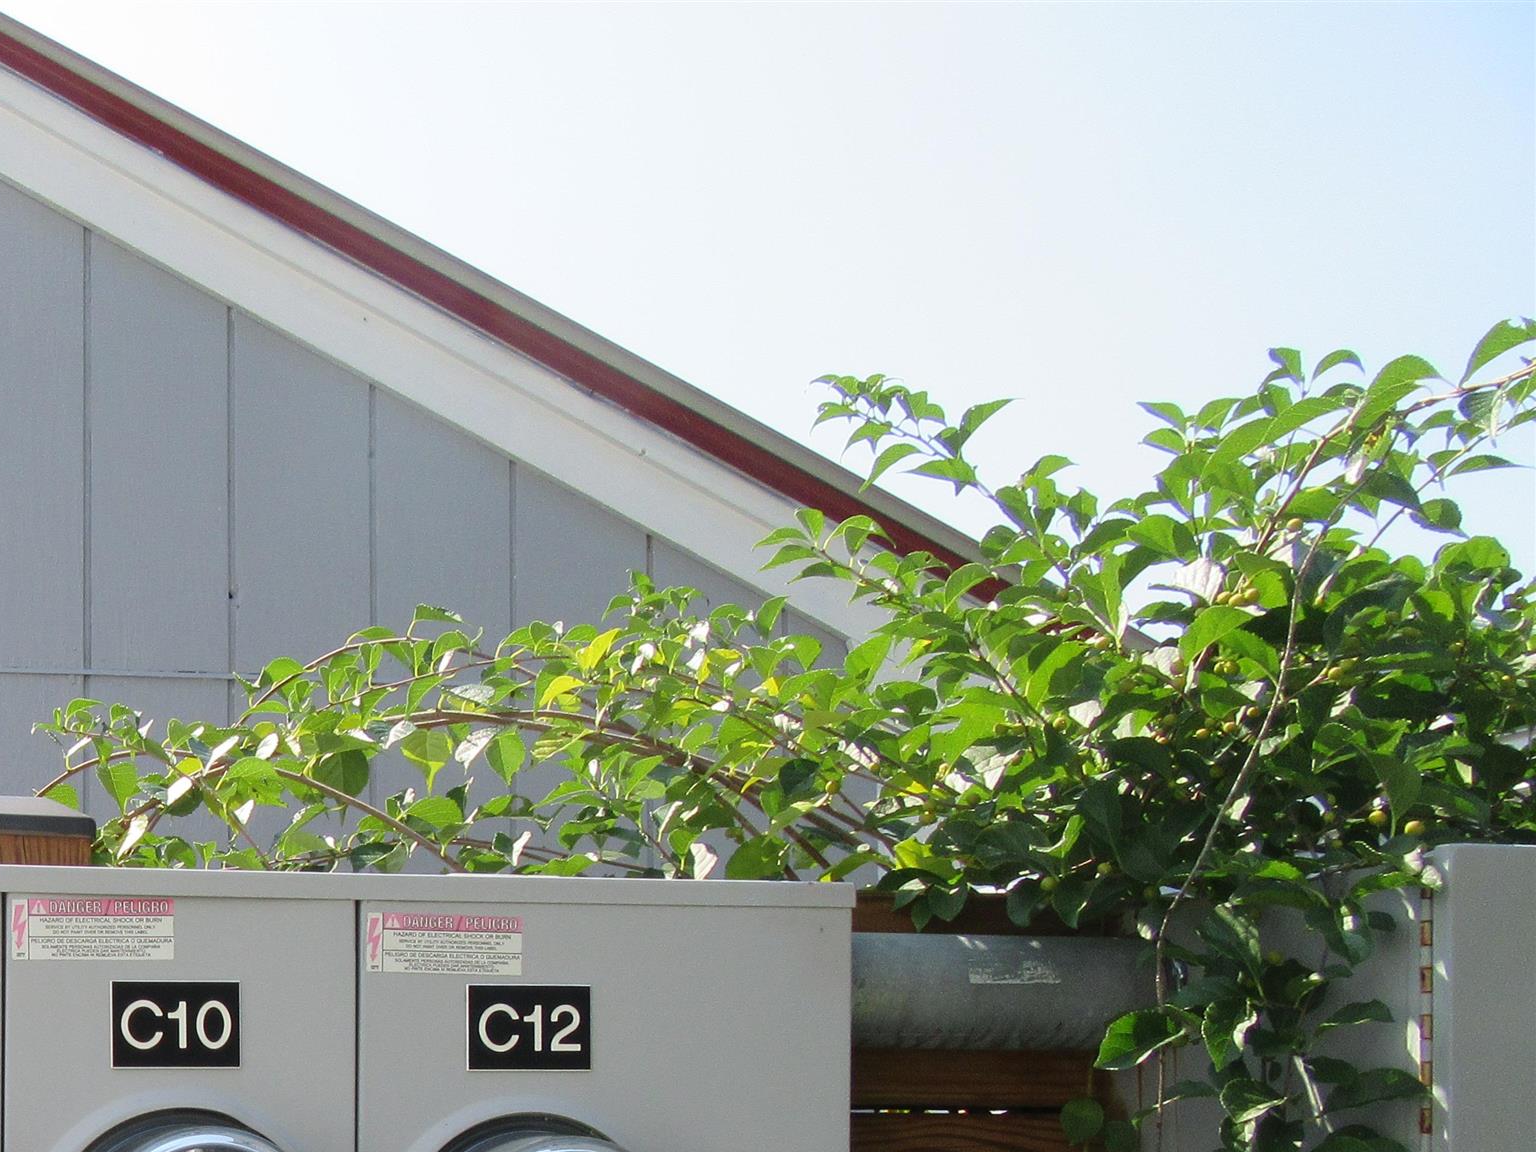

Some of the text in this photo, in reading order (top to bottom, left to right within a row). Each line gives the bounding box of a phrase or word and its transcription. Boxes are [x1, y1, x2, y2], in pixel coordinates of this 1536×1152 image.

[49, 901, 168, 912] DANGER PELIGRO
[404, 916, 517, 929] DANGER PELIGRO
[120, 999, 232, 1050] C10
[478, 1003, 582, 1053] C12
